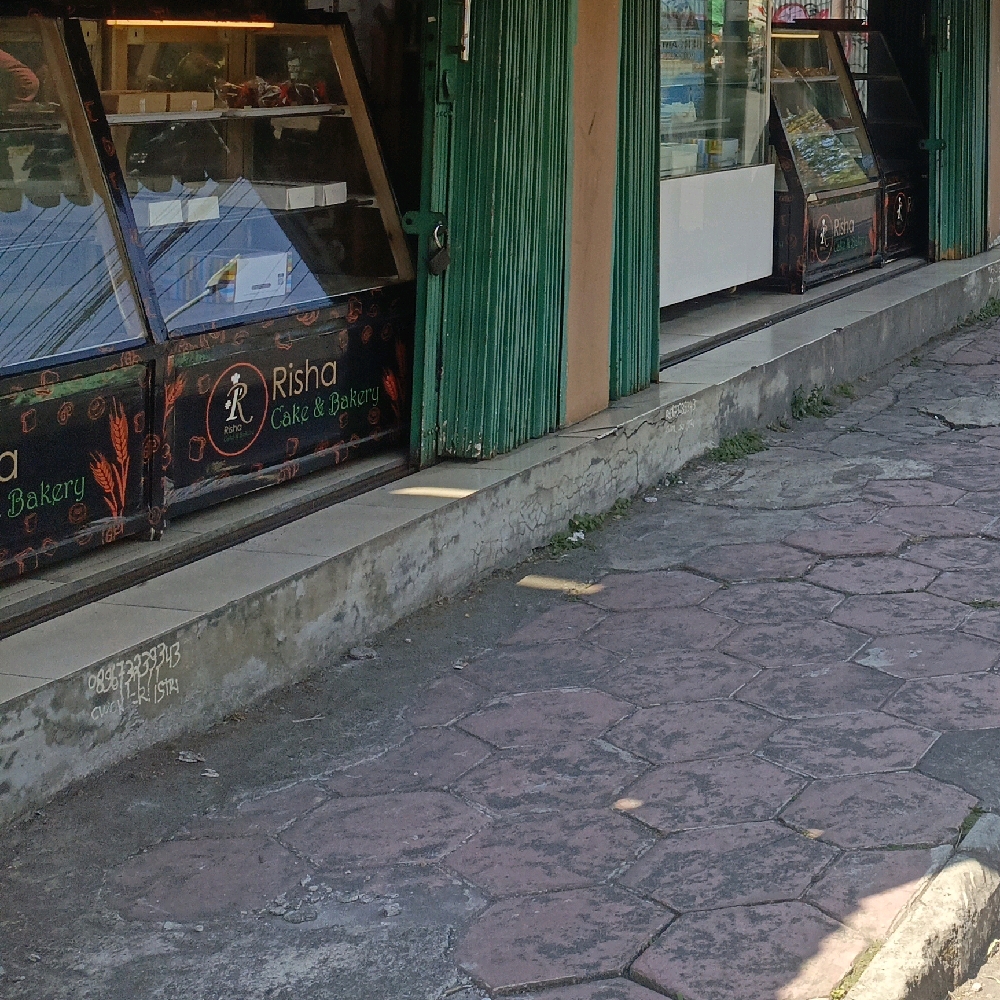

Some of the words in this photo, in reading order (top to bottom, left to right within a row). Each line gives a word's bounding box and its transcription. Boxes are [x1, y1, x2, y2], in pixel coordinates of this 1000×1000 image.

[272, 358, 337, 401] Risha
[270, 404, 309, 430] Cake
[313, 396, 326, 418] &
[328, 385, 380, 417] Bakery
[7, 476, 86, 518] Bakery
